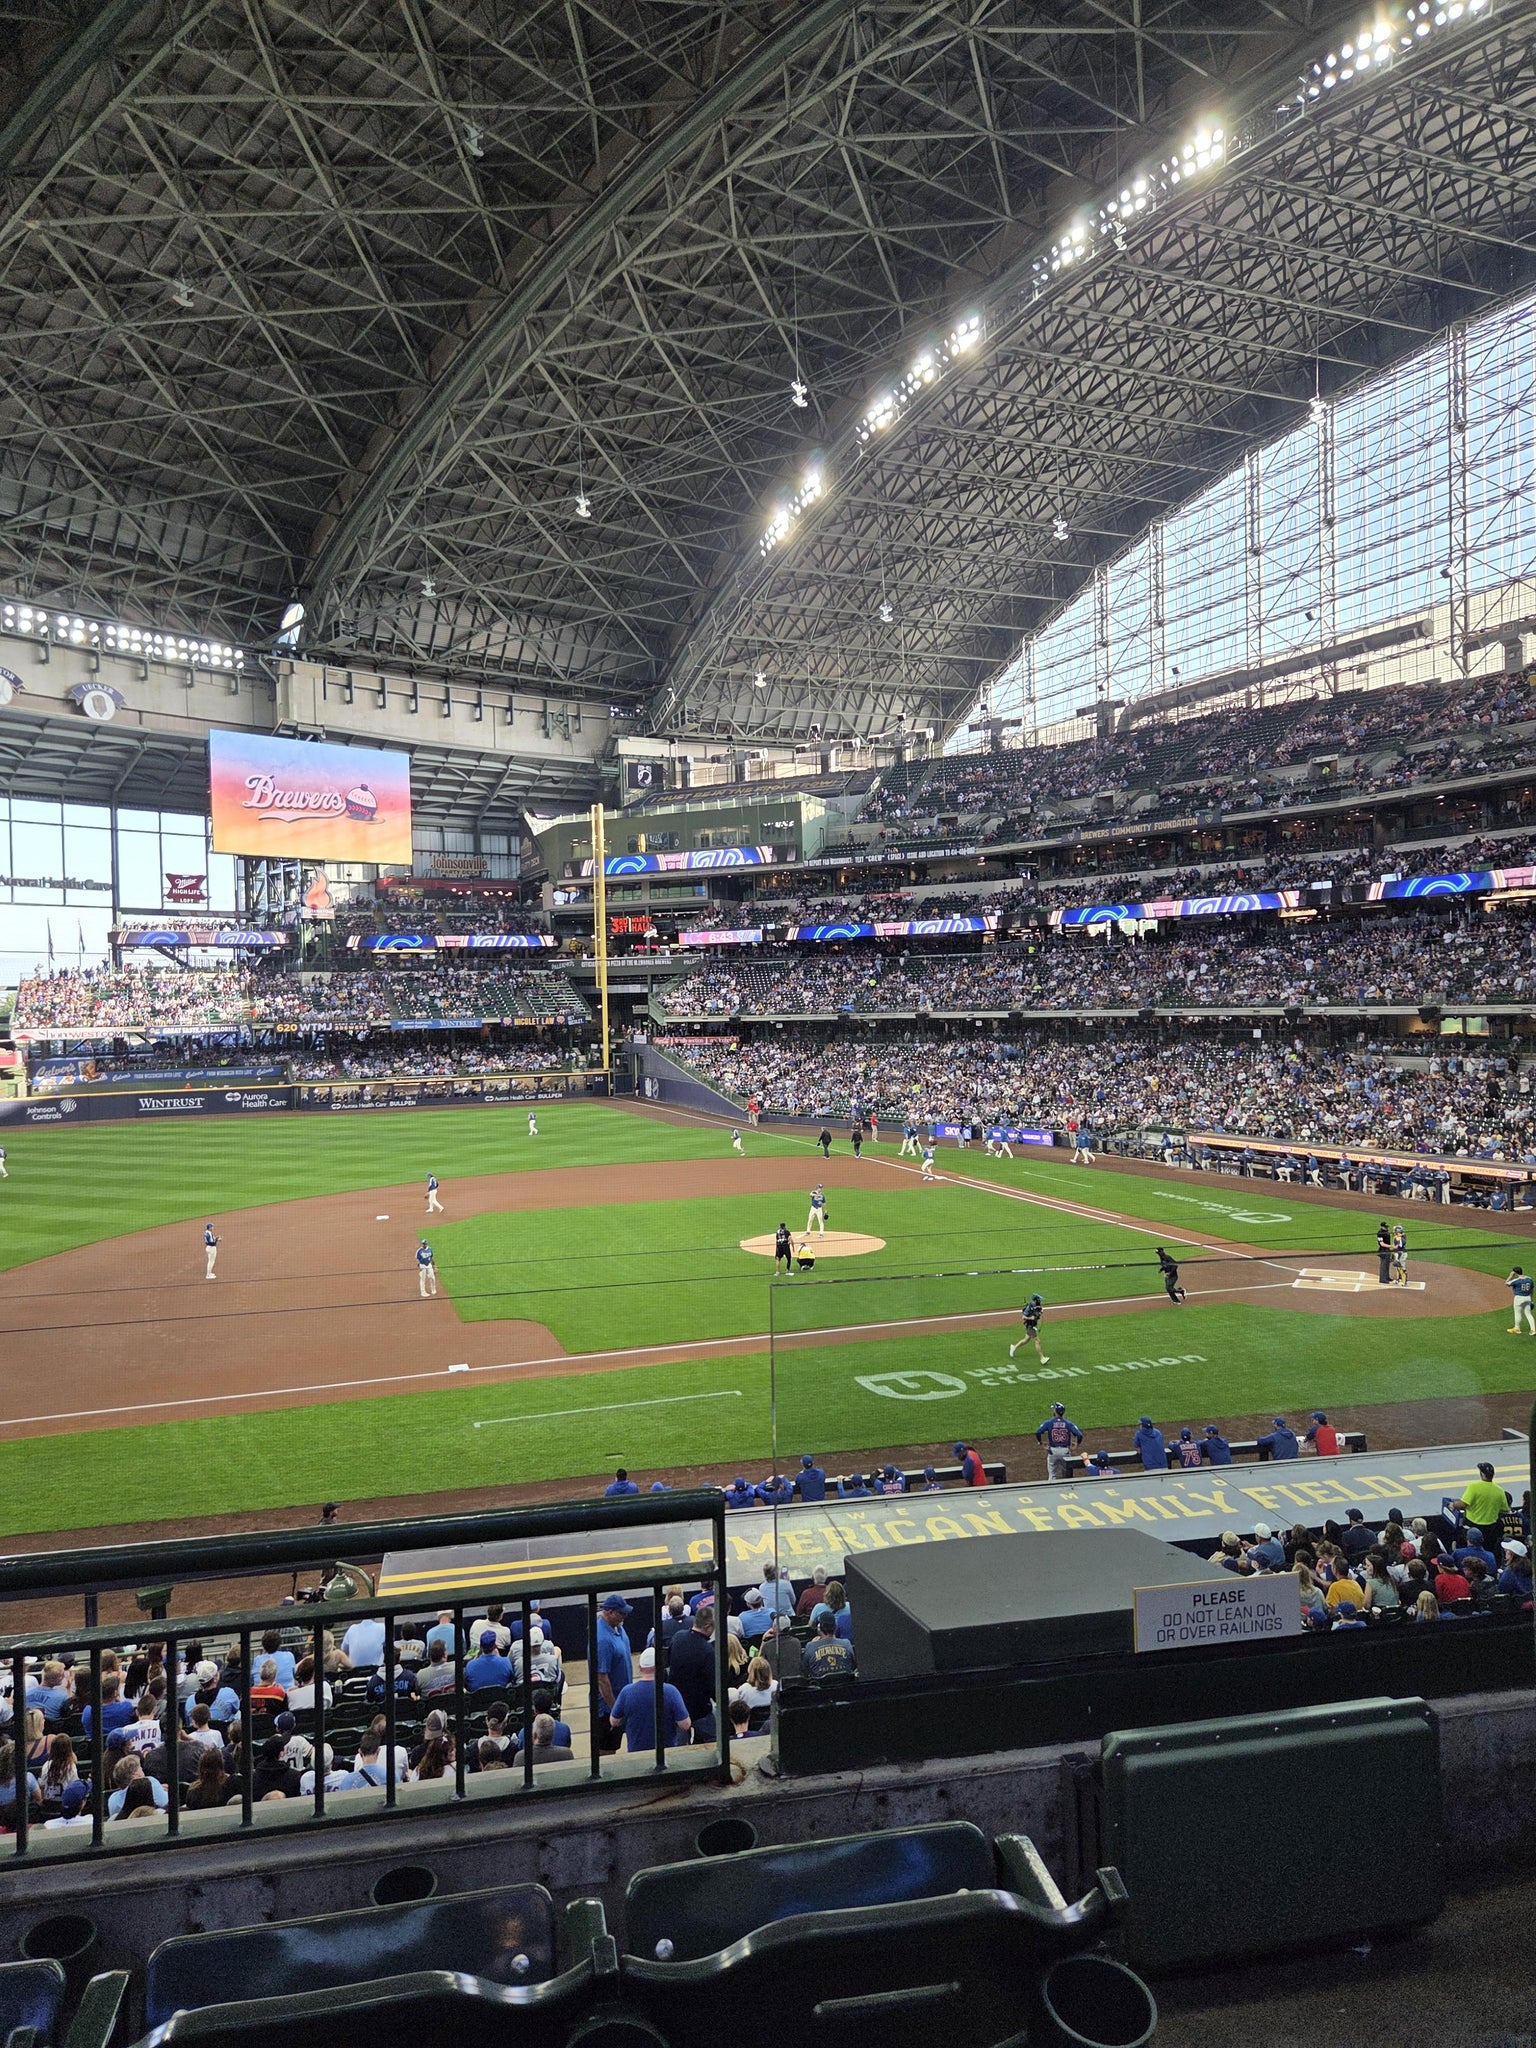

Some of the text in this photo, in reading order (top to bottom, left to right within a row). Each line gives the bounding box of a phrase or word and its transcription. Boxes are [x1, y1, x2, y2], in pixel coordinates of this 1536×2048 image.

[81, 682, 115, 695] UECKER
[242, 775, 346, 822] Brewers
[658, 793, 692, 801] MUST
[728, 787, 754, 795] THE
[1080, 816, 1199, 840] BREWERS COMMUNITY FOUNDATION
[431, 855, 488, 870] Johnsonville
[0, 875, 39, 887] Aurora
[41, 876, 81, 890] Health
[174, 878, 197, 888] Miller
[708, 932, 733, 942] 6:43
[276, 1022, 333, 1033] 620 WTMJ
[514, 1016, 555, 1026] NICOLET LAW
[162, 1027, 181, 1035] GREAT
[210, 1025, 239, 1033] CALORIES.
[242, 1092, 268, 1102] Aurora
[537, 1092, 563, 1100] BULLPEN
[26, 1105, 57, 1115] Johnson
[138, 1097, 204, 1111] WINTRUST
[242, 1099, 287, 1109] Health Care
[389, 1099, 416, 1108] BULLPEN
[32, 1112, 62, 1121] Controls
[964, 1364, 1020, 1378] uw
[981, 1353, 1208, 1387] credit union
[846, 1478, 1228, 1521] WELCOME TO
[687, 1475, 1403, 1564] AMERICAN FAMILY FIELD
[1501, 1515, 1524, 1526] YELICH
[1503, 1525, 1523, 1538] 22
[1193, 1590, 1246, 1607] PLEASE
[1163, 1603, 1276, 1627] DO NOT LEAN ON
[1157, 1618, 1283, 1643] OR OVER RAILINGS
[814, 1646, 848, 1662] MILWAUKEE
